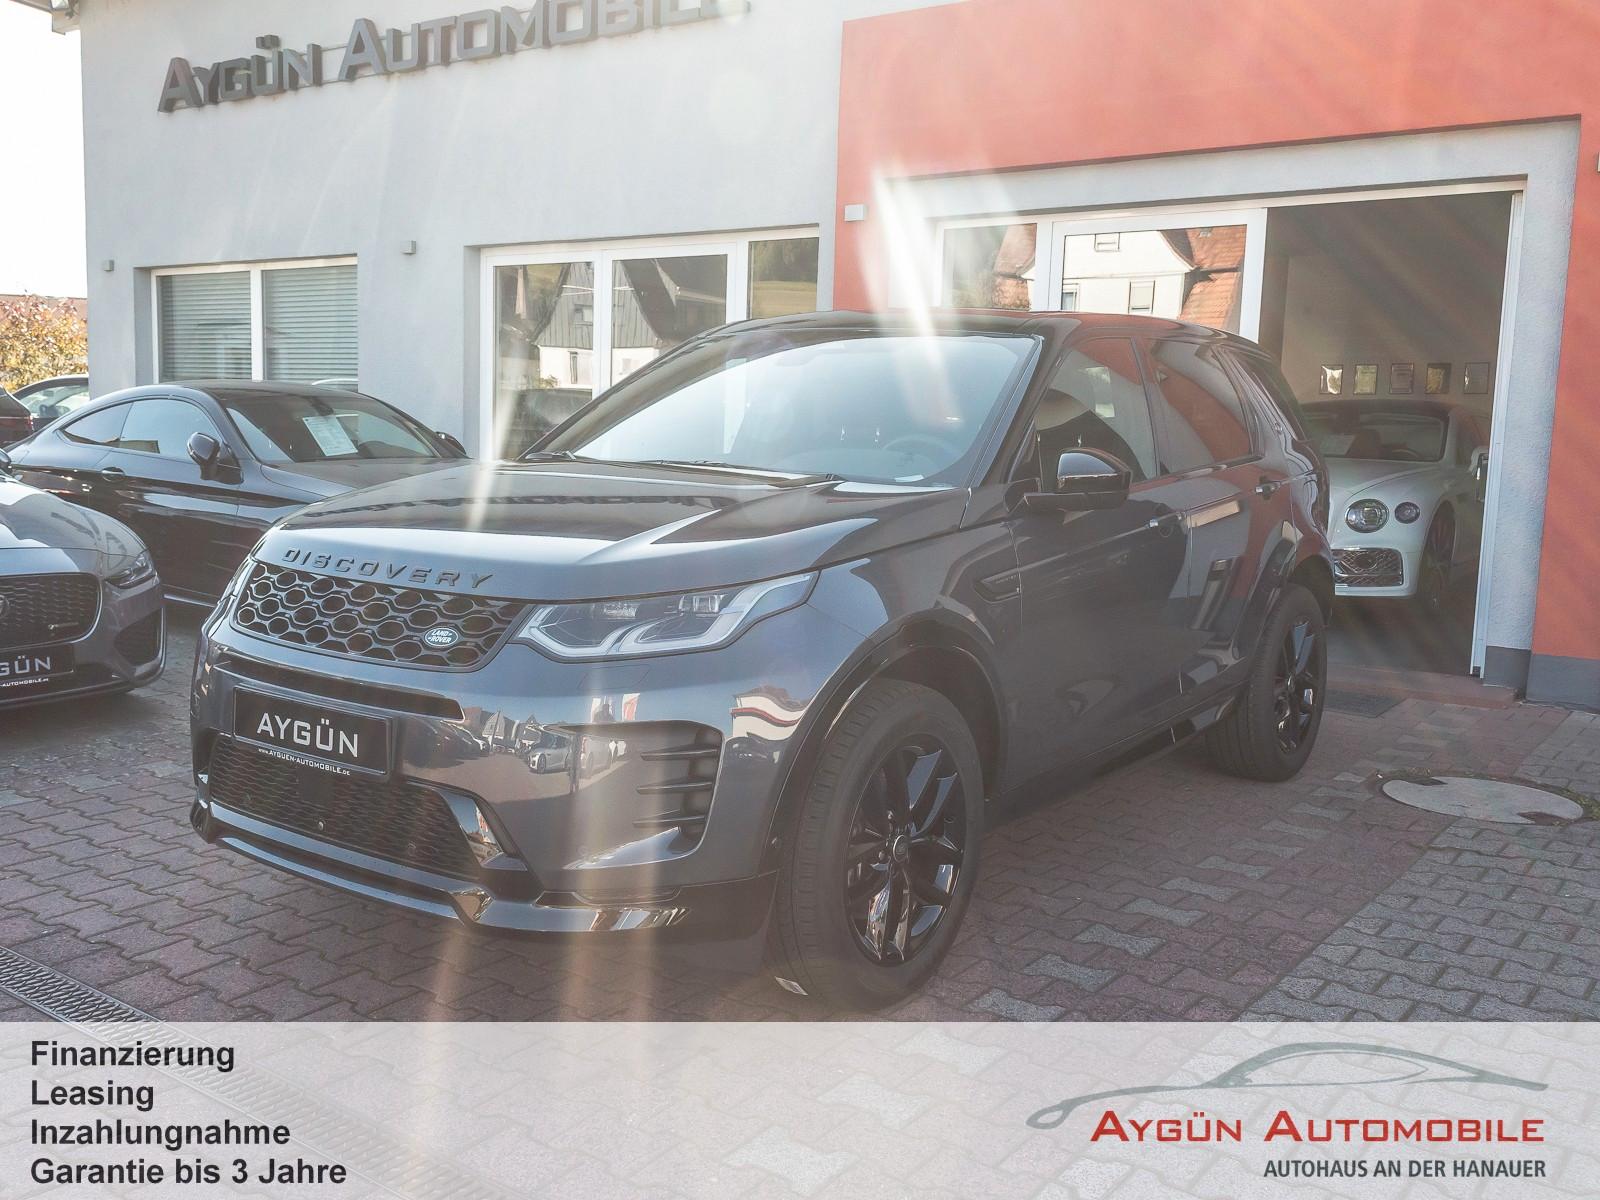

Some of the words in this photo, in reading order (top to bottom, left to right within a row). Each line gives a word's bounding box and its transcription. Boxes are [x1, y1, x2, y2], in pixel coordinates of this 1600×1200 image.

[157, 35, 322, 112] AYGÜN
[337, 0, 749, 81] AUTOMOBIL
[282, 548, 493, 589] DISCOVERY
[431, 635, 451, 643] ROVER
[256, 713, 358, 758] AYGÜN
